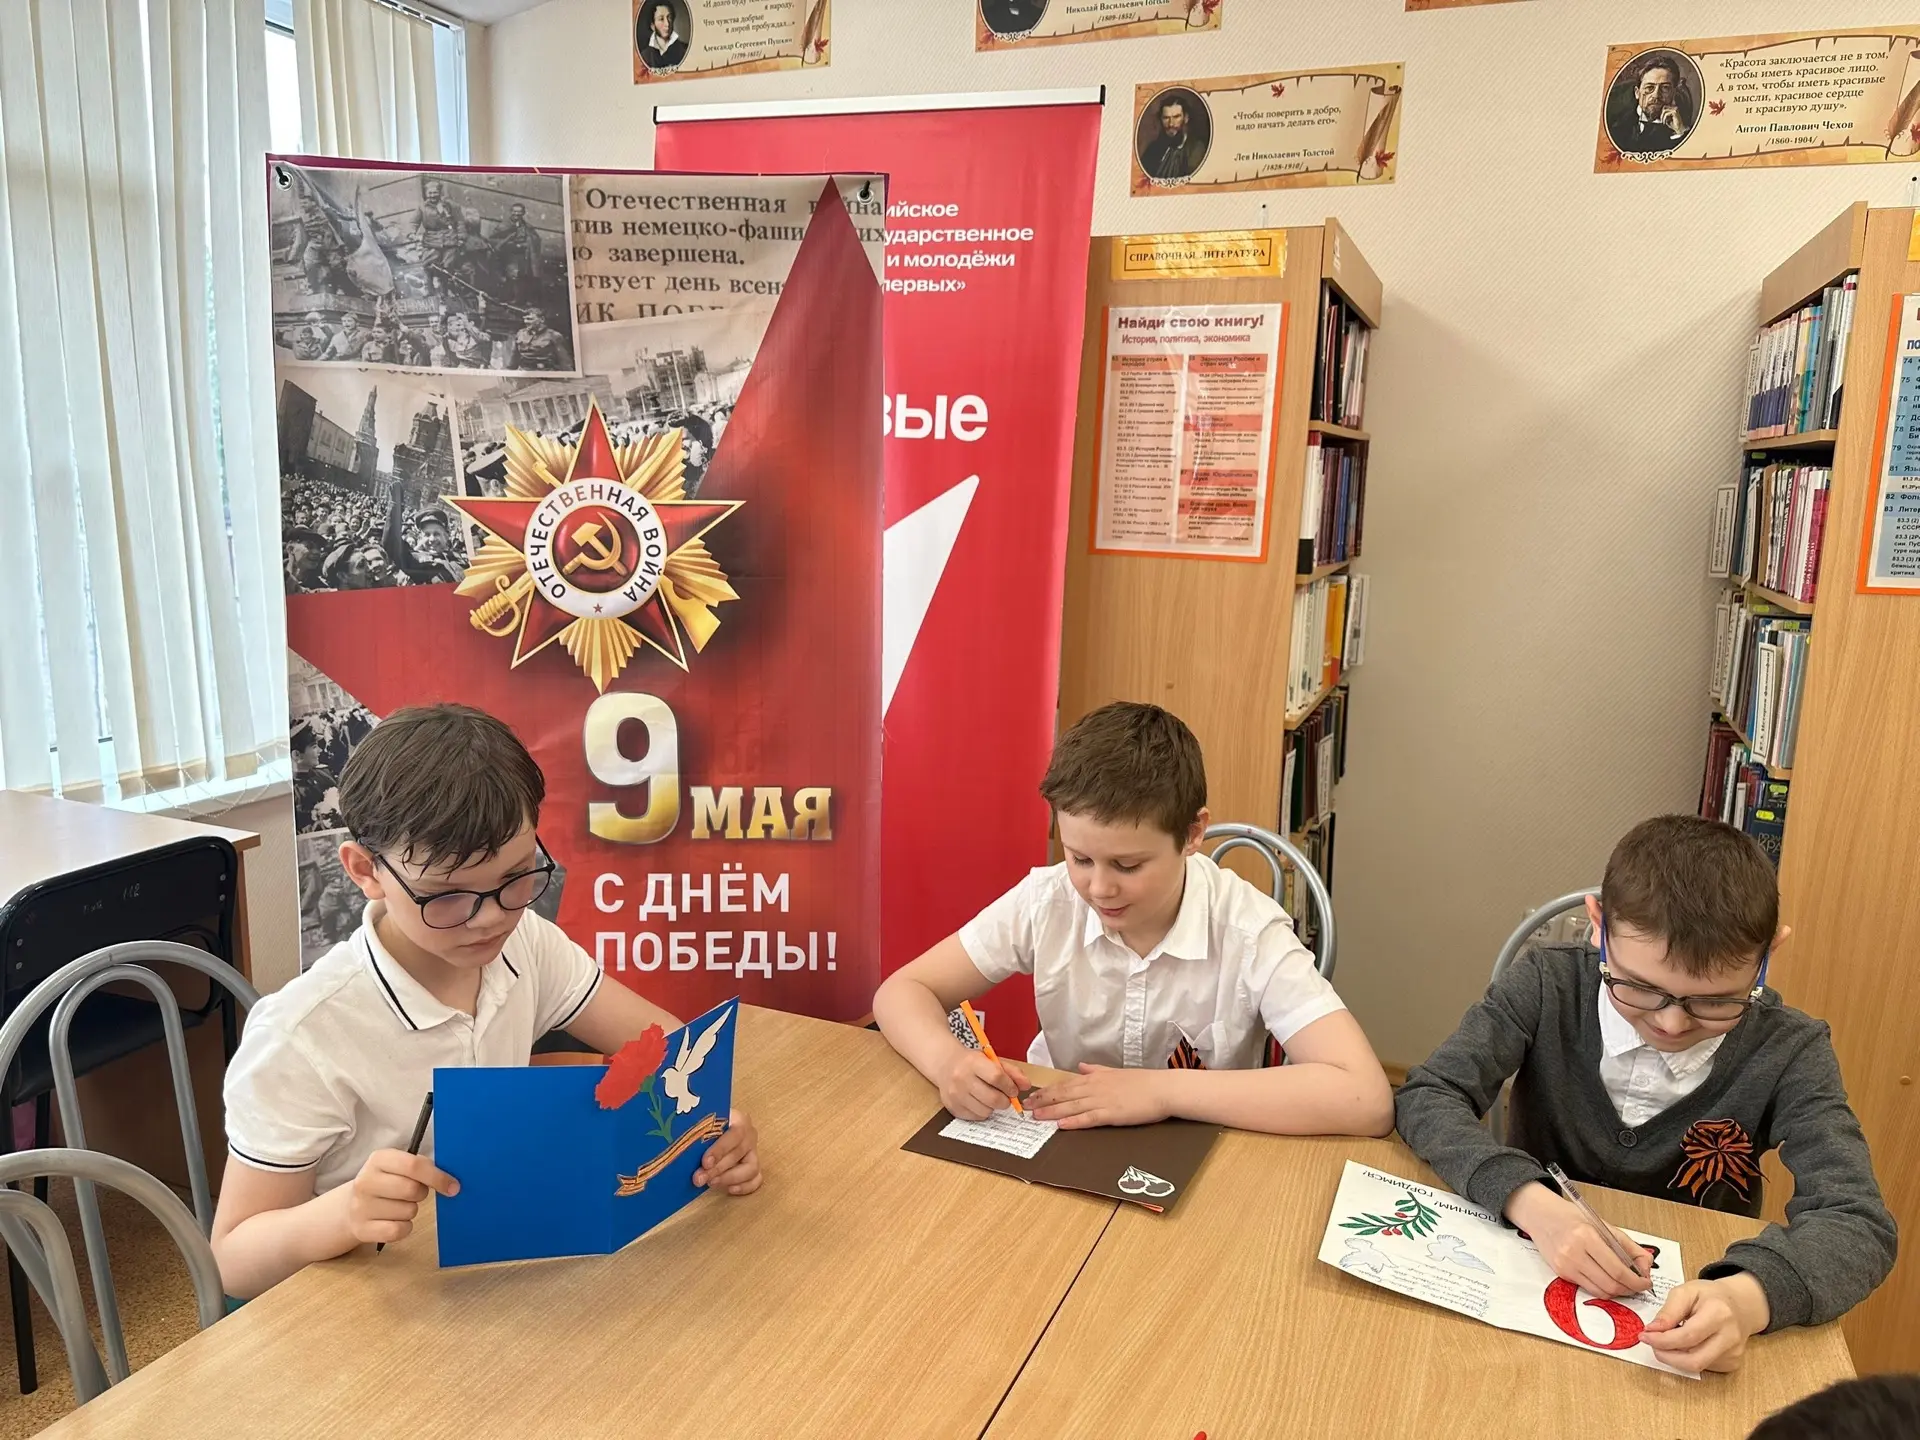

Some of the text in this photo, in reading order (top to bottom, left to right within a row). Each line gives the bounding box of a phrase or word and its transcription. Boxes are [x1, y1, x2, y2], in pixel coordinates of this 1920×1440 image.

[1066, 3, 1098, 14] Николай
[1100, 0, 1144, 11] Васильевич
[703, 14, 764, 27] Что чувства добрые
[1097, 12, 1136, 23] /1809-1852/
[703, 37, 793, 53] Александр Сергеевич Пушкин
[1719, 57, 1766, 69] «Красота
[1769, 54, 1838, 66] заключается
[1840, 53, 1854, 62] не
[1864, 51, 1889, 61] том,
[1725, 64, 1879, 81] чтобы иметь красивое лицо.
[1716, 82, 1725, 92] А
[1736, 83, 1758, 92] том,
[1761, 79, 1795, 90] чтобы
[1797, 79, 1830, 88] иметь
[1832, 75, 1886, 87] красивые
[1733, 89, 1864, 104] мысли, красивое сердце
[1233, 105, 1342, 120] «Чтобы поверить в добро,
[1755, 104, 1808, 116] красивую
[1809, 102, 1847, 113] душу».
[1235, 117, 1338, 132] надо начать делать его».
[1735, 121, 1854, 134] Антон Павлович Чехов
[1765, 135, 1818, 147] /1860-1904/
[1234, 147, 1335, 162] Лев Николаевич Толстой
[1262, 162, 1304, 172] /1828-1910/
[586, 188, 786, 213] Отечественная
[884, 227, 1034, 246] ударственное
[608, 246, 746, 267] завершена.
[887, 250, 1016, 269] и молодёжи
[1129, 248, 1266, 262] СПРАВОЧНАЯ ЛИТЕРАТУРА
[575, 274, 656, 293] ствует
[664, 276, 721, 294] день
[1118, 314, 1264, 330] Найди свою книгу!
[1122, 333, 1251, 344] История, политика, экономика
[530, 484, 663, 602] ОТЕЧЕСТВЕННАЯ ВОЙНА
[583, 691, 832, 845] 9 МАЯ
[594, 862, 790, 922] С ДНЁМ
[595, 930, 837, 979] ПОБЕДЫ!
[1362, 1169, 1498, 1223] ПОМНИМ! ГОРДИМСЯ!
